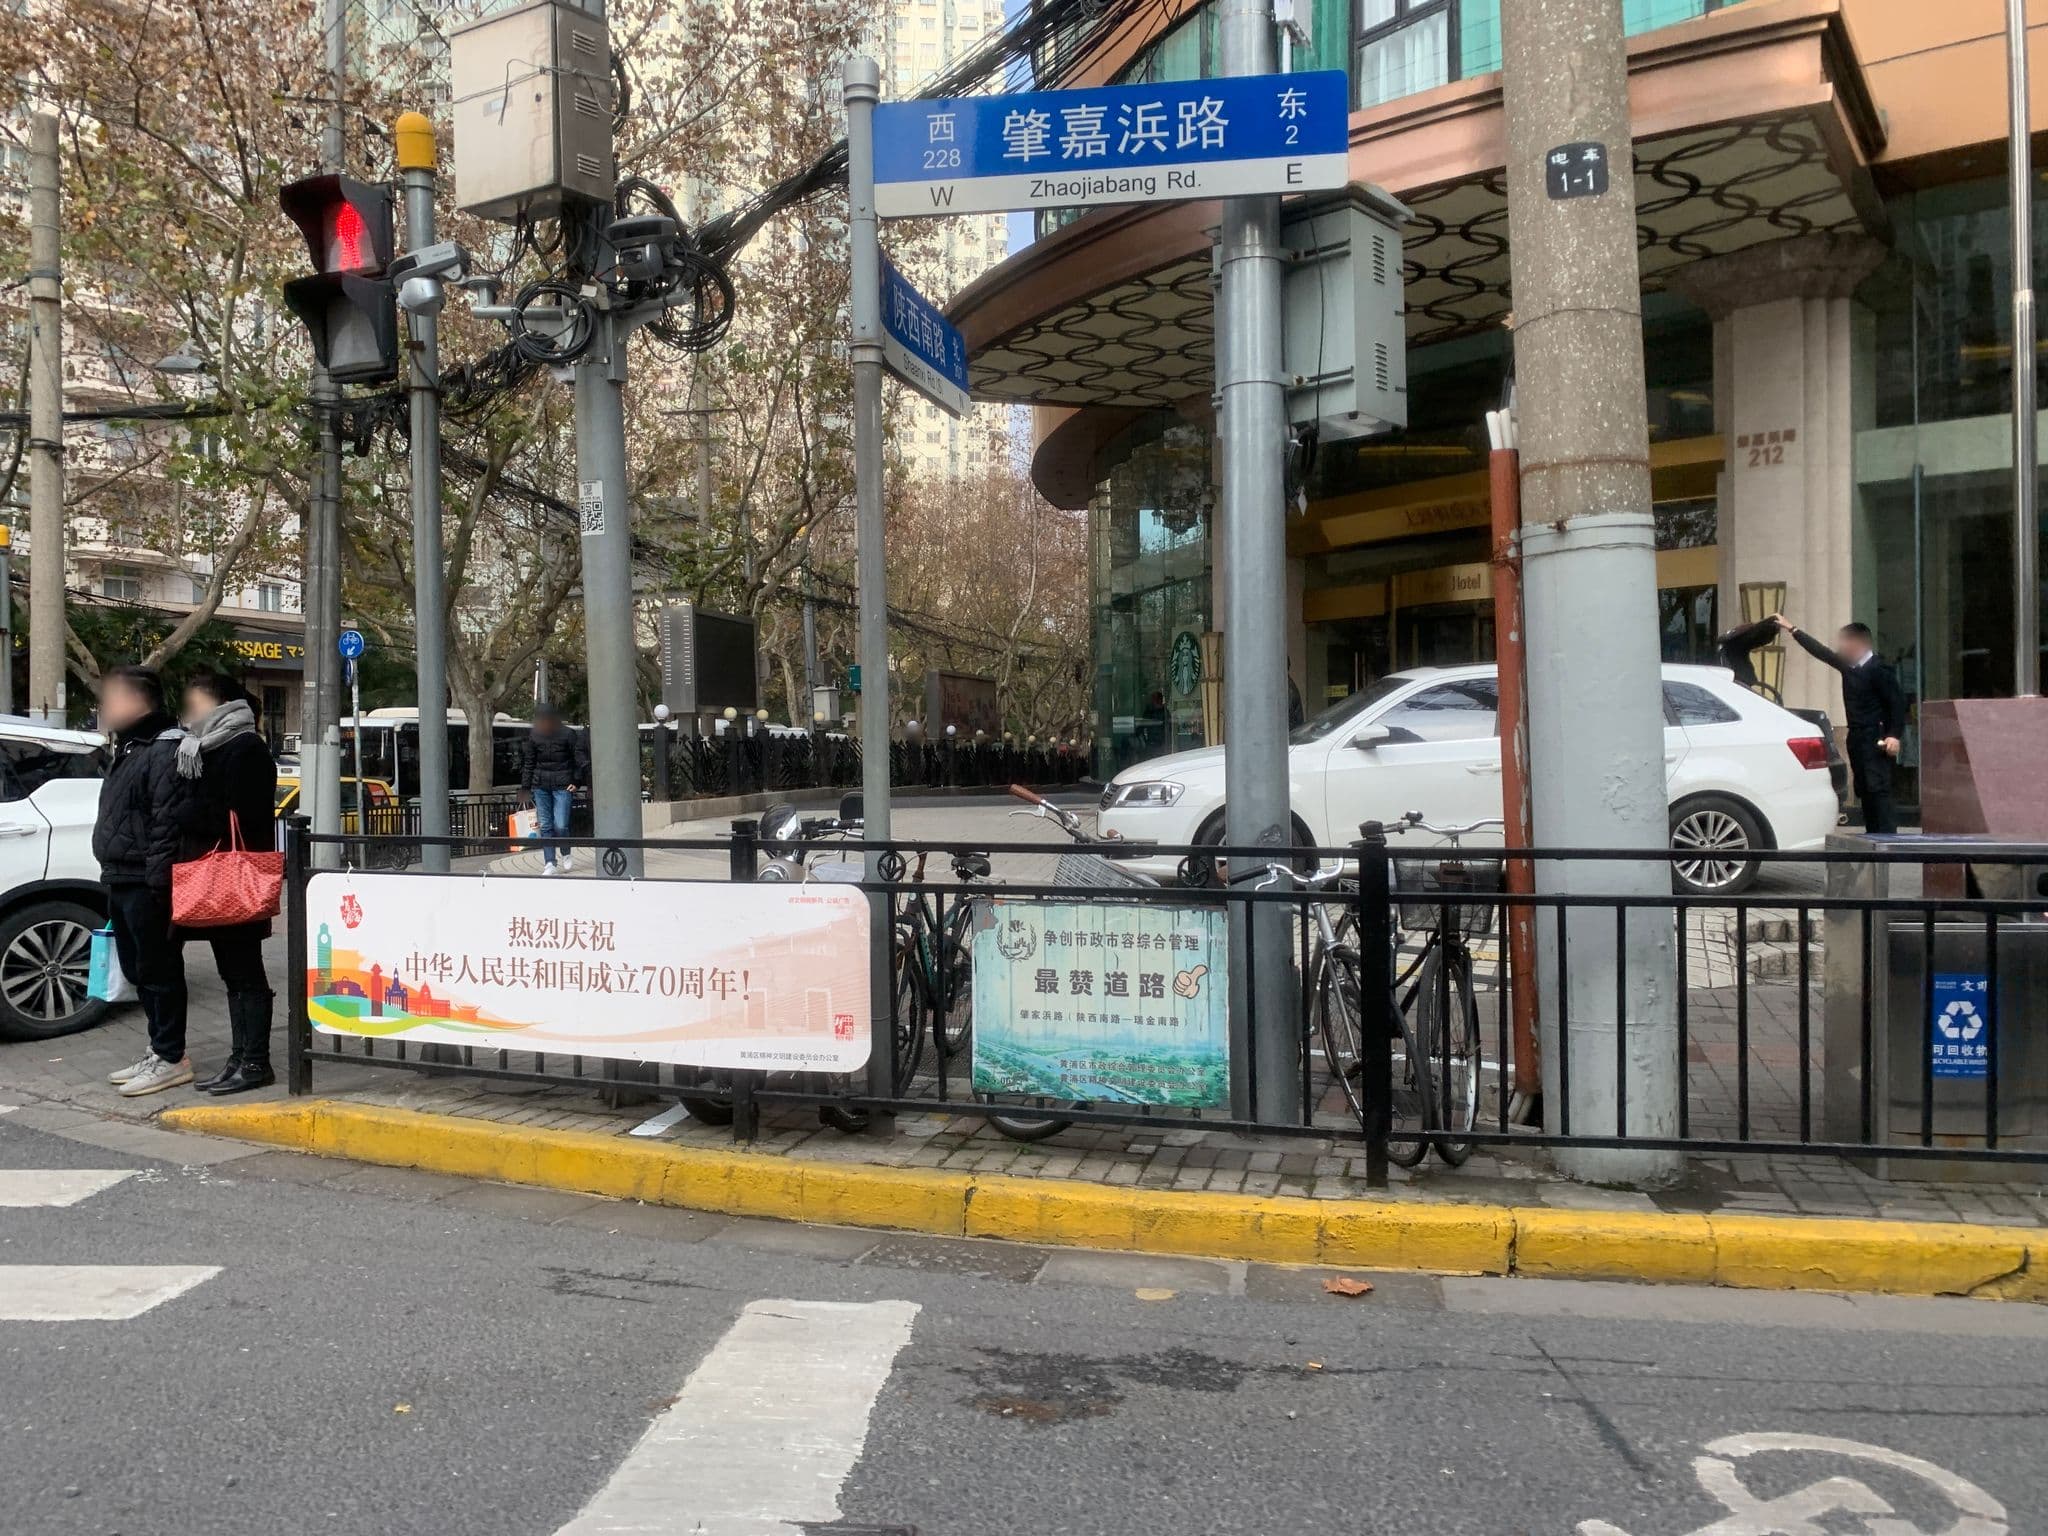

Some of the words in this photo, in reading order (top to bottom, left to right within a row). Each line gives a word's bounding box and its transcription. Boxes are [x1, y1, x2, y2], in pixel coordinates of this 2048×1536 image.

[1276, 87, 1308, 120] 东
[926, 113, 956, 144] 西
[1001, 95, 1230, 163] 肇嘉浜路
[1284, 124, 1299, 146] 2
[922, 149, 962, 170] 228
[1029, 174, 1157, 199] Zhaojiabang
[1167, 169, 1202, 190] Rd.
[1286, 162, 1304, 185] E
[1561, 168, 1594, 193] 1-1
[929, 185, 955, 207] W
[892, 282, 947, 369] 陕西南路
[1748, 445, 1784, 468] 212
[507, 915, 616, 952] 热烈庆祝
[1043, 929, 1200, 951] 争创市政市容综合管理
[1034, 967, 1166, 999] 最赞道路
